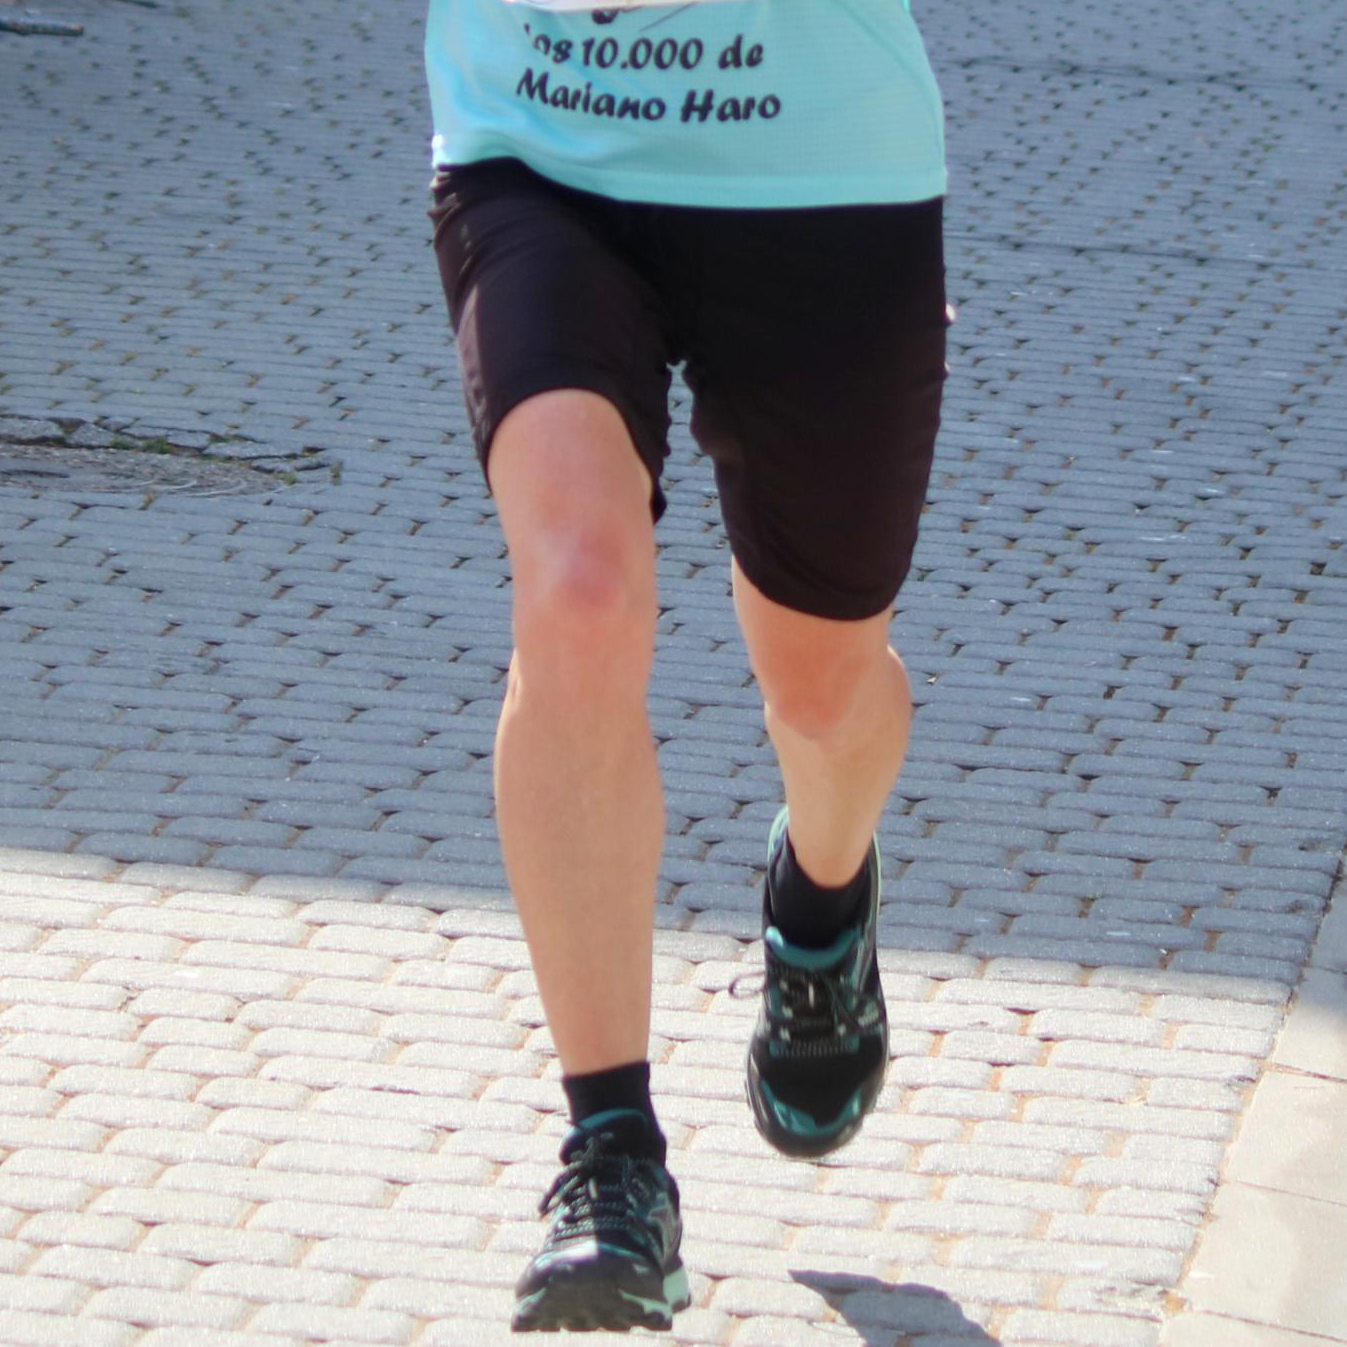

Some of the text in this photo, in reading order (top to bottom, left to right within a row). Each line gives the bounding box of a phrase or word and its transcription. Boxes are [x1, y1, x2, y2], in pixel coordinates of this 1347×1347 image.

[523, 22, 765, 70] os 10.000 de
[515, 67, 782, 123] Mariano Haro
